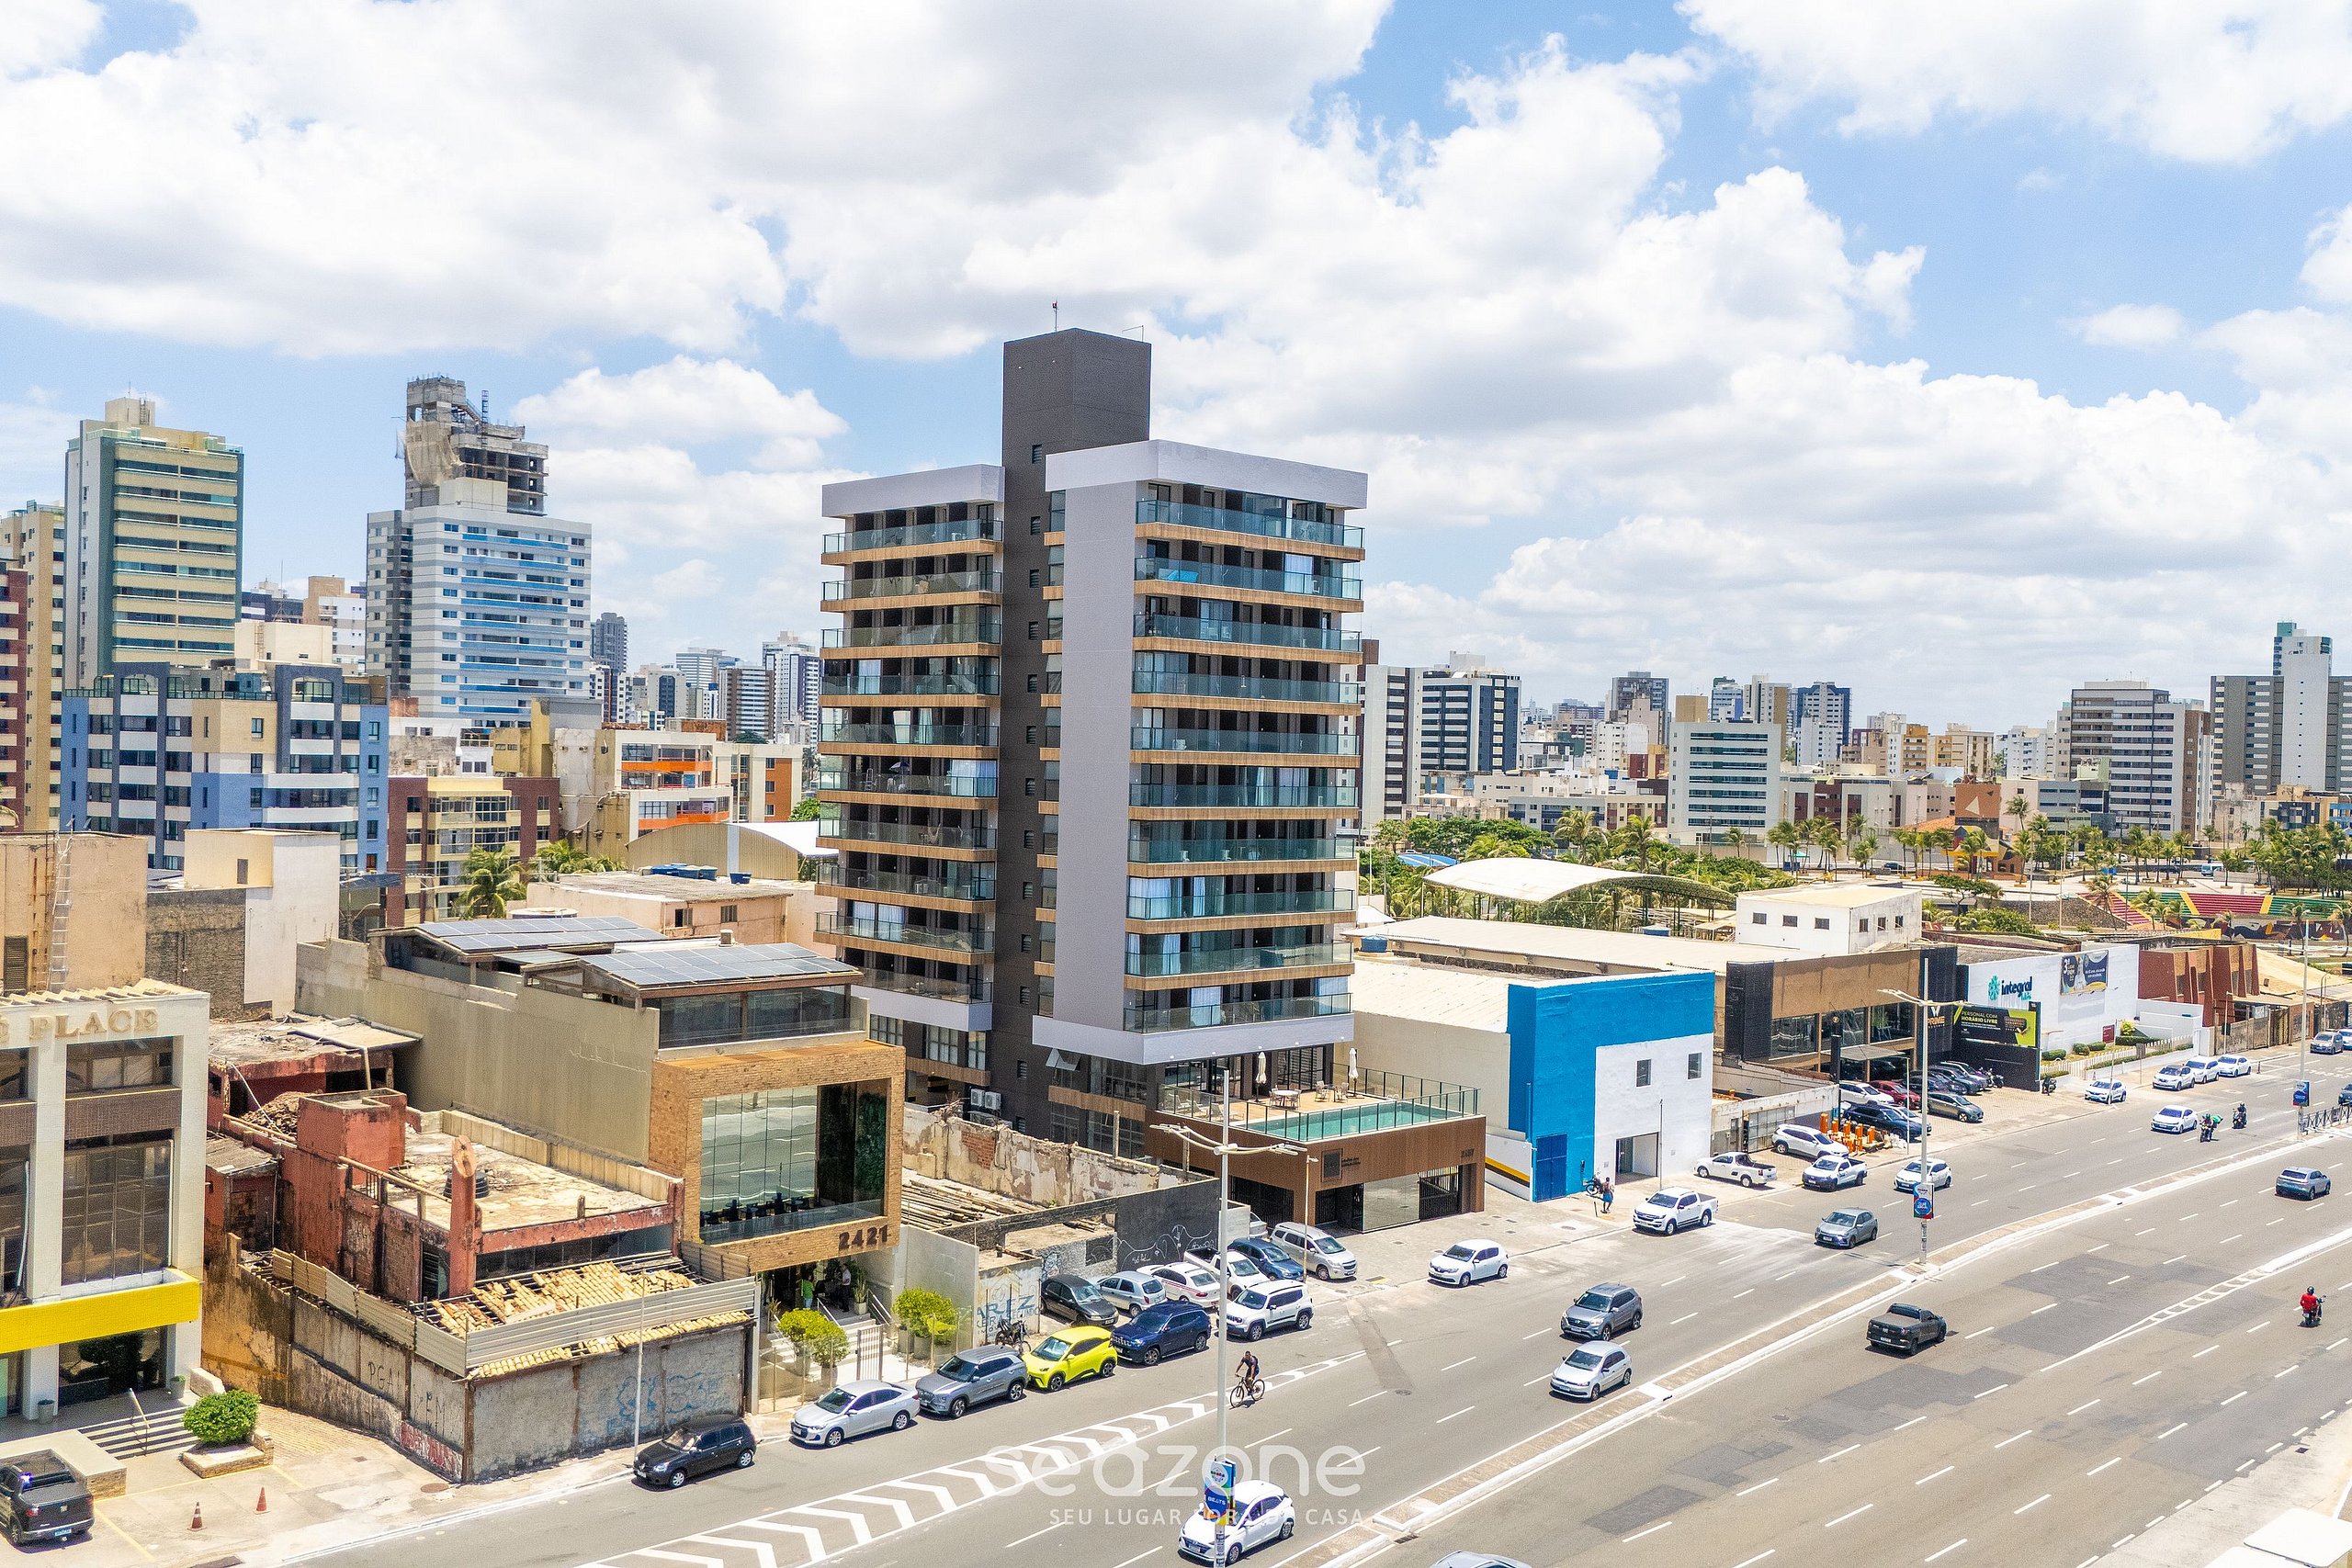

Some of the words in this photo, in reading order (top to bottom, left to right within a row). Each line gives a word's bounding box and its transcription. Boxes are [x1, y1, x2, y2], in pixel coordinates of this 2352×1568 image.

[2001, 976, 2032, 998] integral
[1961, 1015, 1984, 1023] HORÁRIO
[1962, 1010, 1985, 1019] PERSONAL
[28, 1008, 158, 1040] PLACE
[838, 1224, 888, 1251] 2421
[1207, 1495, 1227, 1506] BEATS
